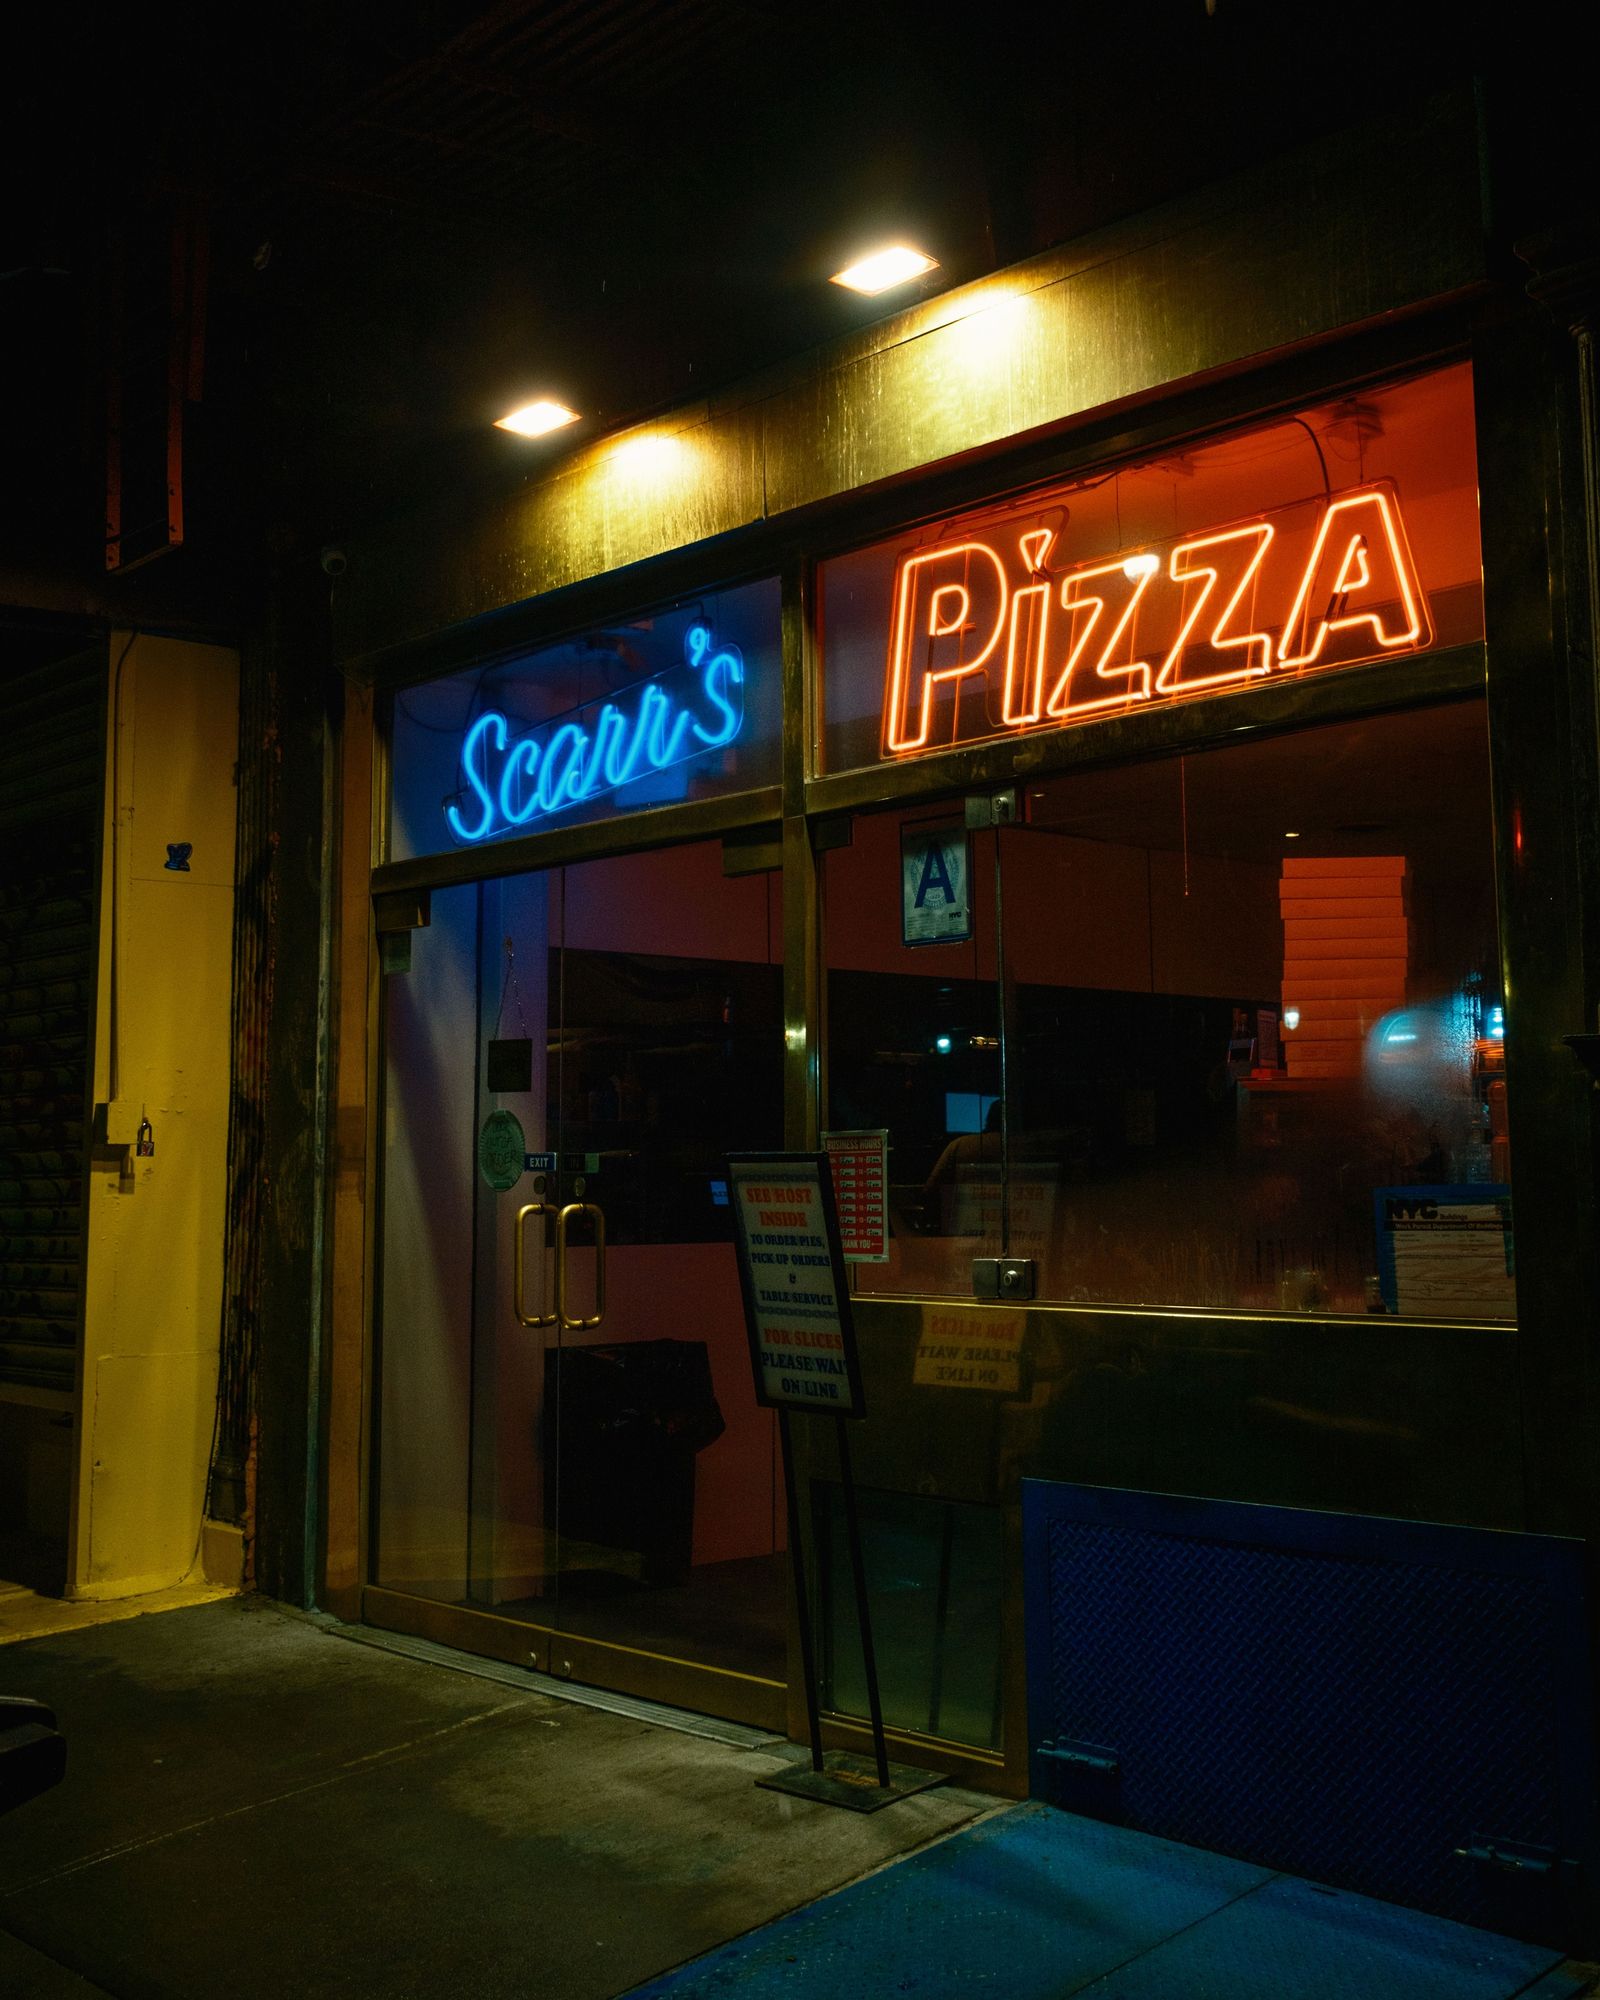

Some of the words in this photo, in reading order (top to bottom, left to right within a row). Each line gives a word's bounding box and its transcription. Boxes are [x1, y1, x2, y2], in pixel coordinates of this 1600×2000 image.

[447, 626, 744, 841] Scarr's
[914, 842, 956, 908] A
[949, 911, 961, 919] NYC
[827, 1138, 858, 1151] BUSINESS
[860, 1138, 882, 1150] HOURS
[529, 1157, 550, 1168] EXIT
[746, 1187, 772, 1204] SEE
[775, 1187, 812, 1205] HOST
[1385, 1198, 1438, 1220] NYC
[760, 1211, 807, 1228] INSIDE
[751, 1233, 764, 1245] TO
[764, 1234, 798, 1247] ORDER
[800, 1235, 826, 1249] PIES,
[859, 1239, 872, 1250] YOU
[752, 1252, 774, 1265] PICK
[776, 1254, 789, 1266] UP
[791, 1254, 831, 1267] ORDERS
[760, 1290, 790, 1304] TABLE
[792, 1291, 834, 1306] SERVICE
[764, 1328, 791, 1346] FOR
[794, 1329, 843, 1350] SLICES
[760, 1351, 813, 1373] PLEASE
[782, 1377, 801, 1395] ON
[804, 1380, 839, 1400] LINE
